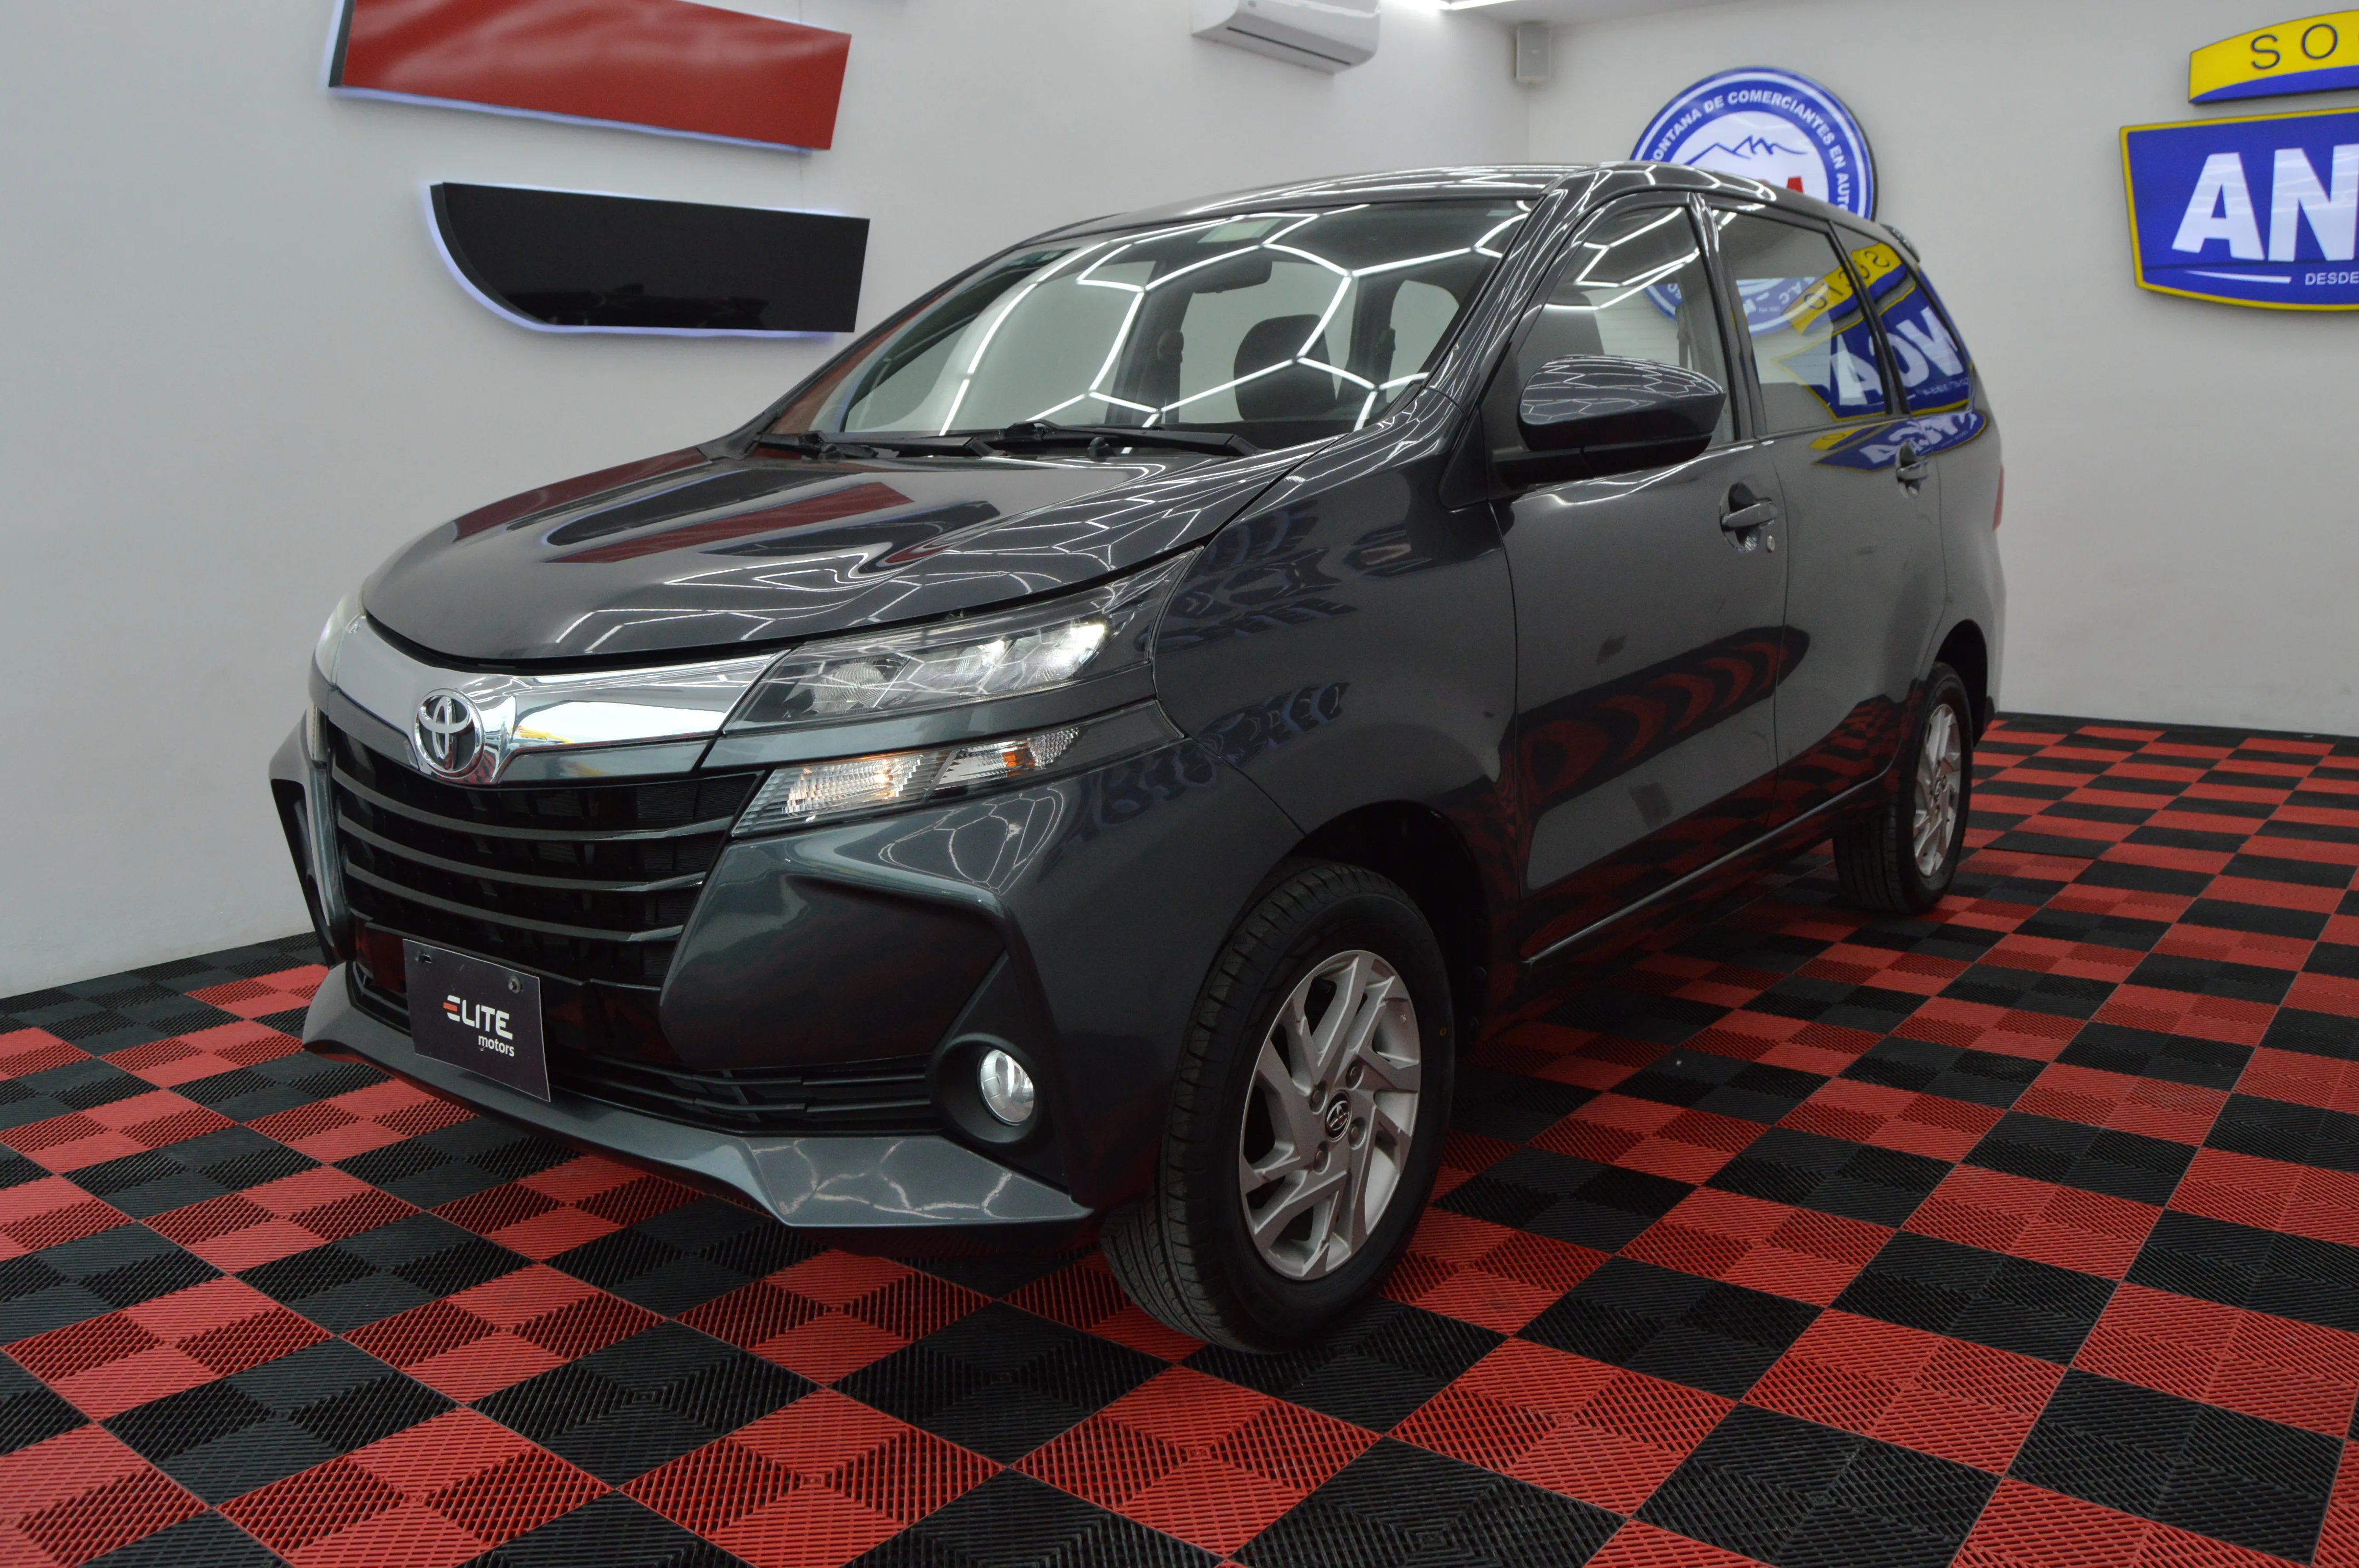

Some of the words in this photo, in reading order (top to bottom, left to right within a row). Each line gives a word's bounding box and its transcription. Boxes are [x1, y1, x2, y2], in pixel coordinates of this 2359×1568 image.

[1651, 108, 1702, 161] ONTANA
[1703, 95, 1724, 113] DE
[1727, 89, 1835, 145] COMERCIANTES
[1829, 144, 1846, 170] EN
[2305, 272, 2359, 285] DESDE
[443, 995, 513, 1040] ELITE
[478, 1035, 514, 1057] motors
